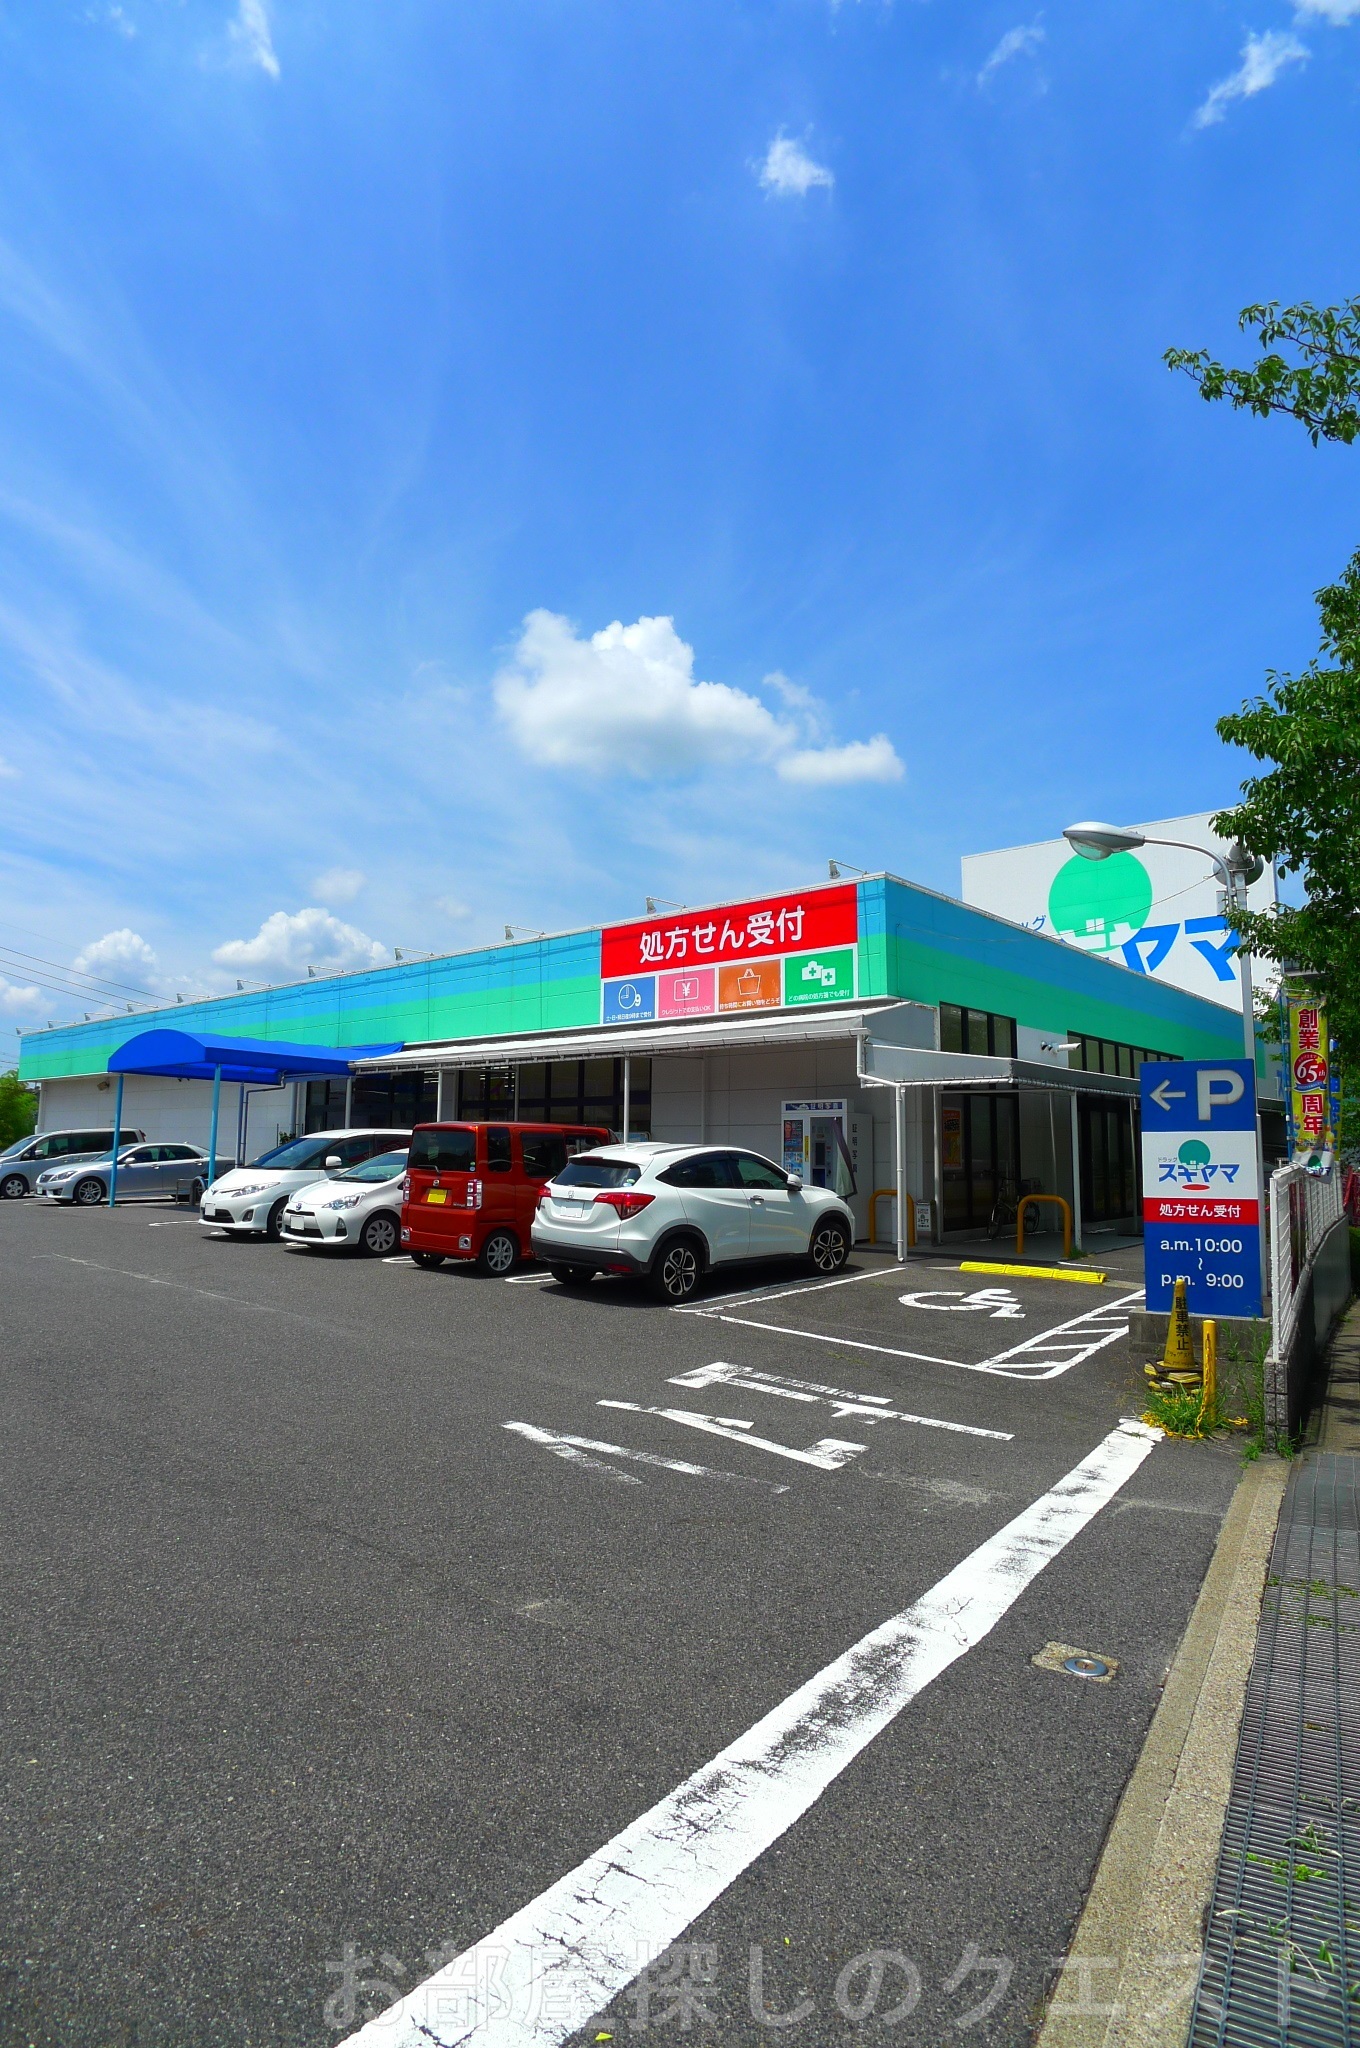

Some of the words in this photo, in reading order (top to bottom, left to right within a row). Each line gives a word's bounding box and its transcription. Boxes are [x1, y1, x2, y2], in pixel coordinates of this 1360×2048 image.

[639, 905, 806, 964] 処方せん受付
[1298, 1008, 1320, 1051] 創業
[1197, 1069, 1245, 1121] P
[1301, 1093, 1324, 1135] 周年
[1159, 1203, 1242, 1218] 処方せん受付
[1161, 1274, 1196, 1287] p.m.
[1206, 1274, 1244, 1289] 9:00
[1175, 1296, 1190, 1351] 駐車禁止
